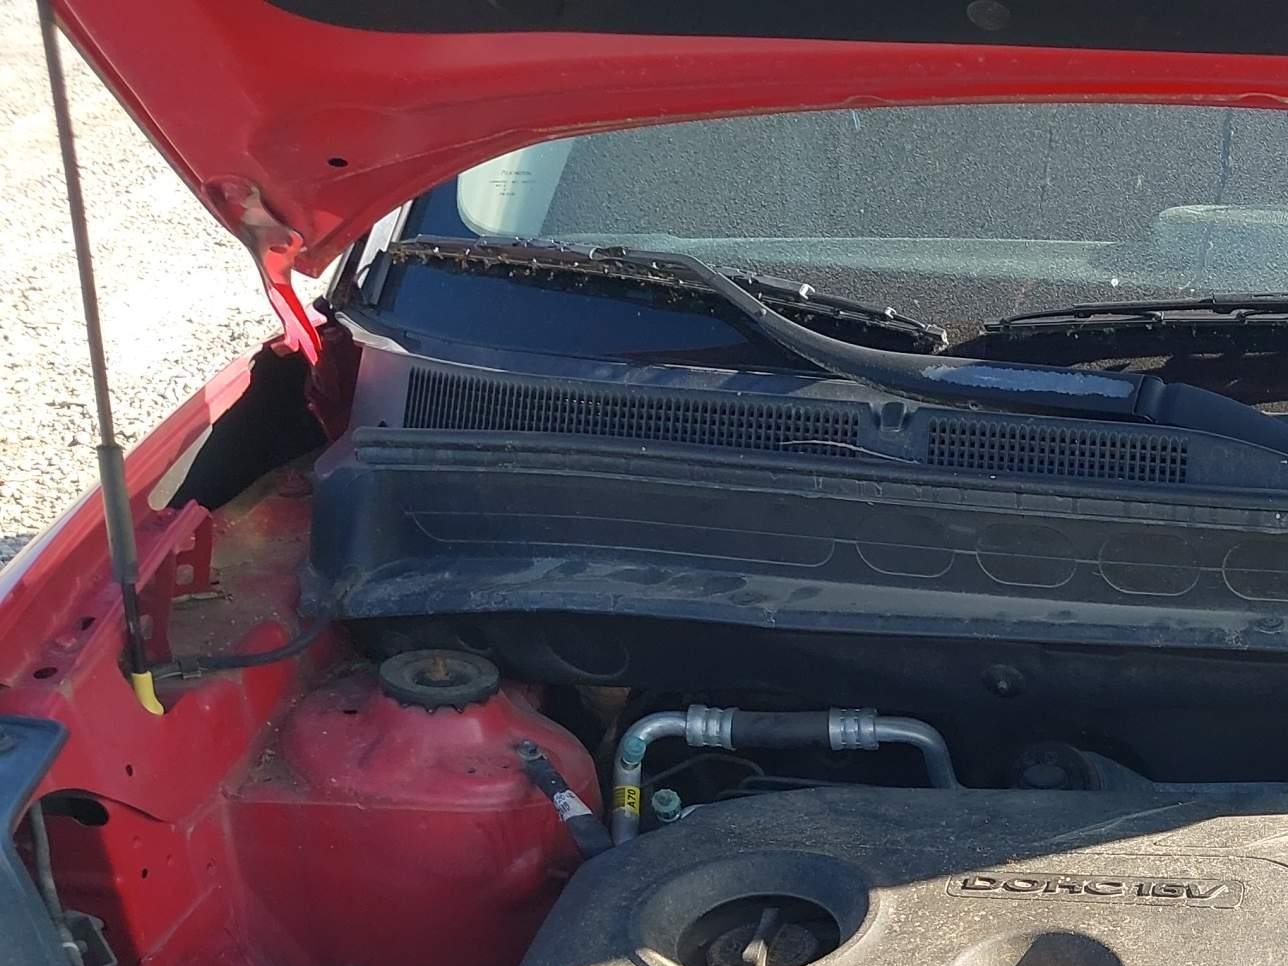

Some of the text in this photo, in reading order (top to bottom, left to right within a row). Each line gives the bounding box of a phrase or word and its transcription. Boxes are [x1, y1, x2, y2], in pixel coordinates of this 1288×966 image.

[626, 788, 637, 809] A70
[960, 875, 1230, 900] DOHC 16V
